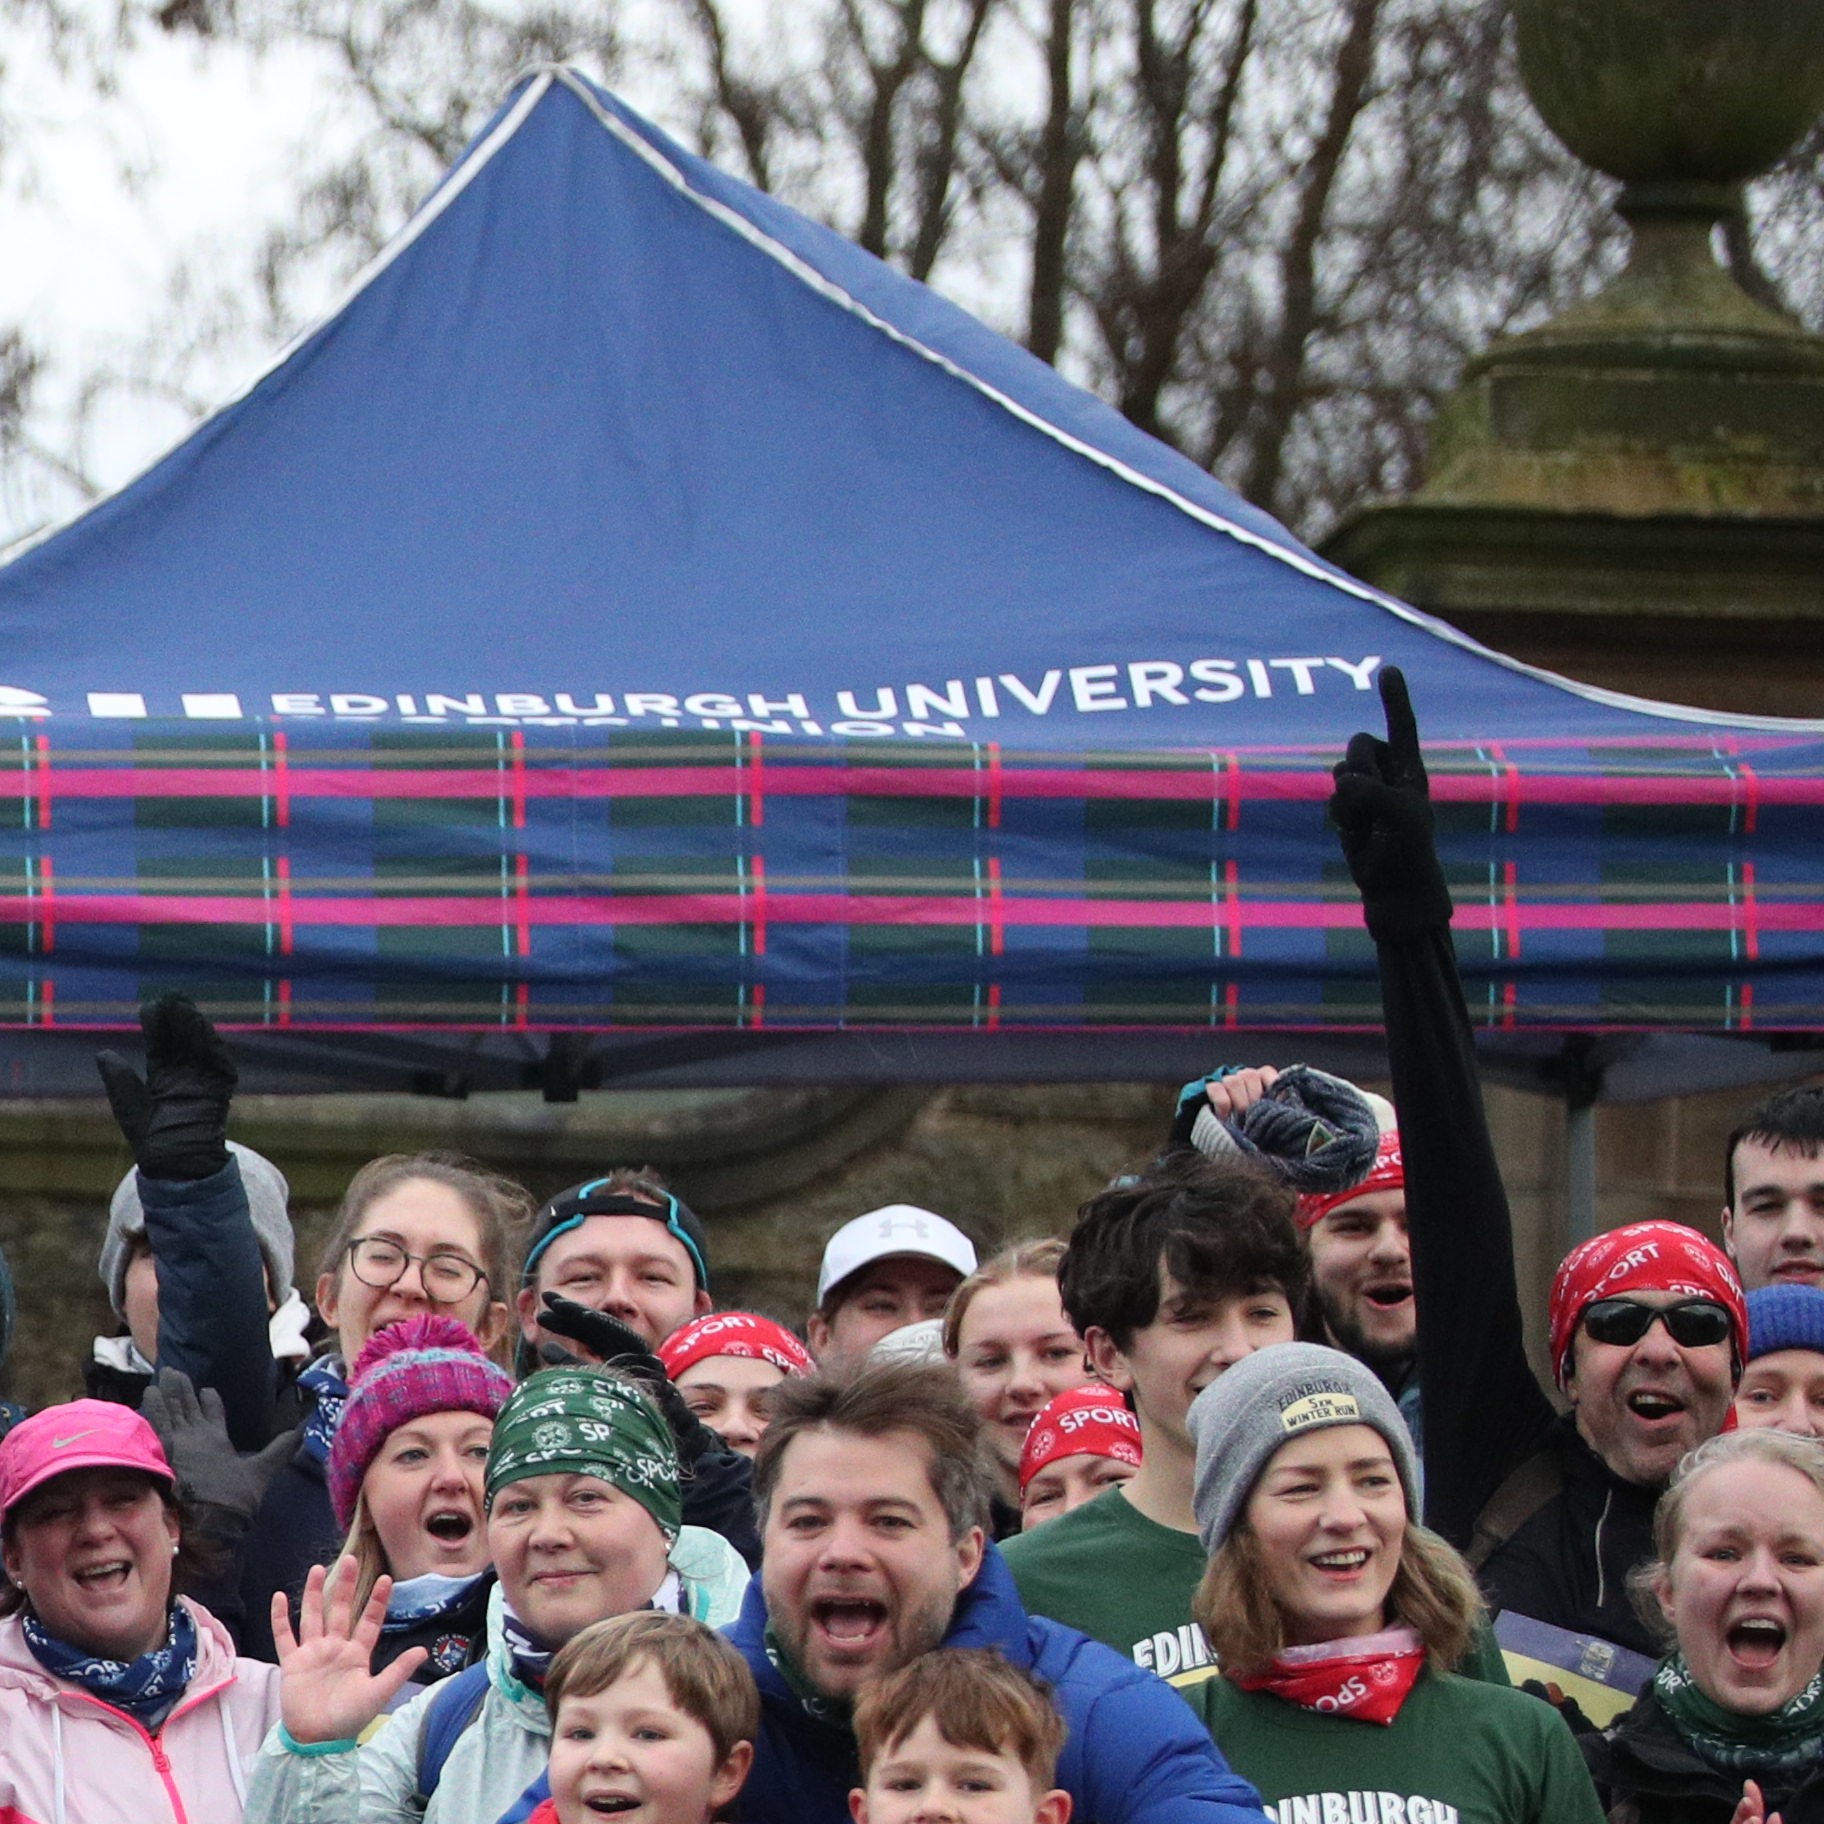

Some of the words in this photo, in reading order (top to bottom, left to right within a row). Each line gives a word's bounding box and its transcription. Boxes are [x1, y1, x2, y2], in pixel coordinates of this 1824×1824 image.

[271, 692, 811, 719] EDINBURGH
[835, 656, 1382, 721] UNIVERSITY
[702, 717, 966, 737] NION
[675, 1315, 757, 1354] SPORT
[1059, 1408, 1140, 1434] SPORT
[1286, 1407, 1332, 1427] WINTER
[1335, 1404, 1356, 1417] RUN
[579, 1422, 615, 1442] SP
[1302, 1675, 1368, 1714] SPO
